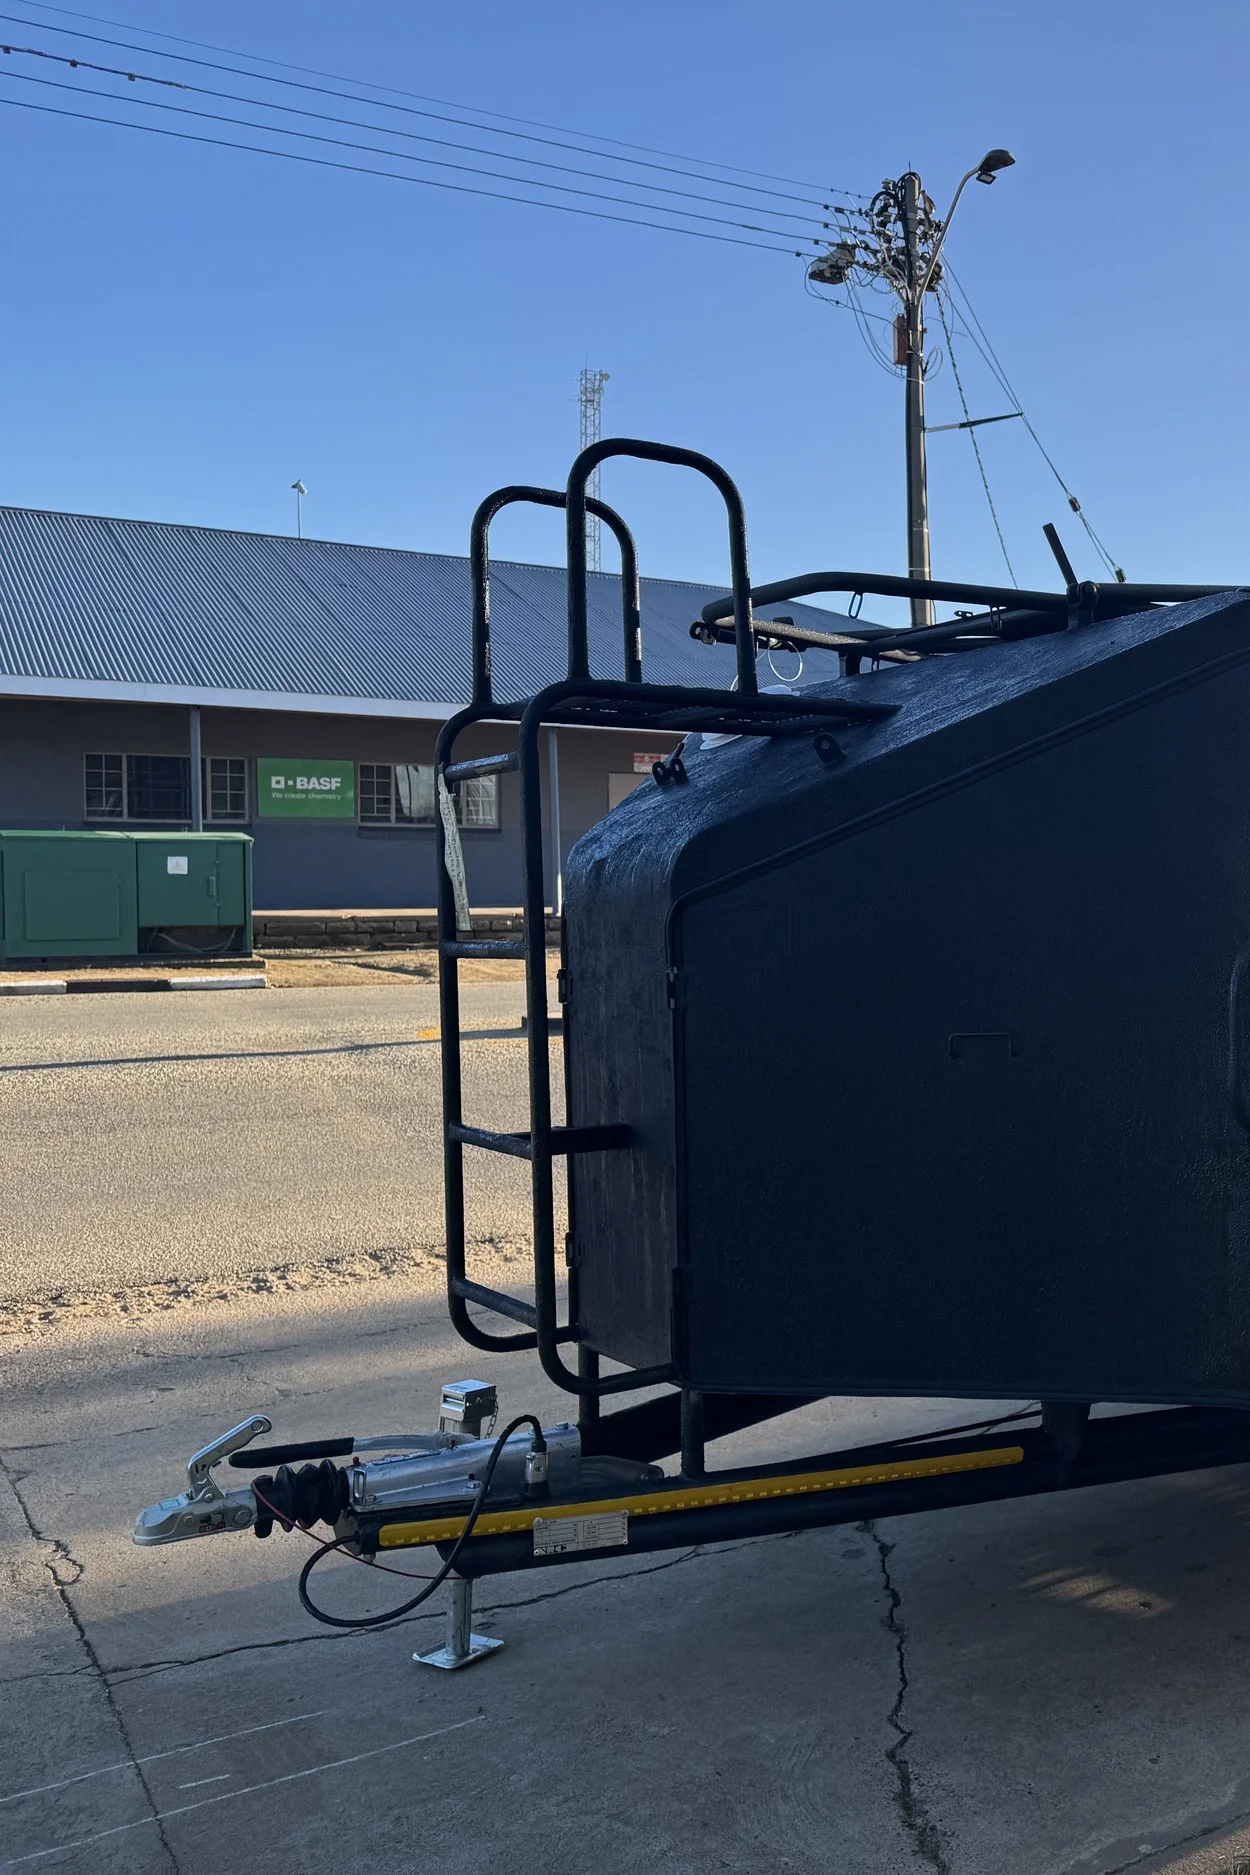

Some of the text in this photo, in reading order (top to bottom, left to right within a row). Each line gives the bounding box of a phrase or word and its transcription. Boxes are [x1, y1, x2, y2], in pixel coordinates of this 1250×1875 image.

[296, 776, 342, 790] BASF
[271, 791, 283, 799] We
[307, 792, 342, 801] chemistry
